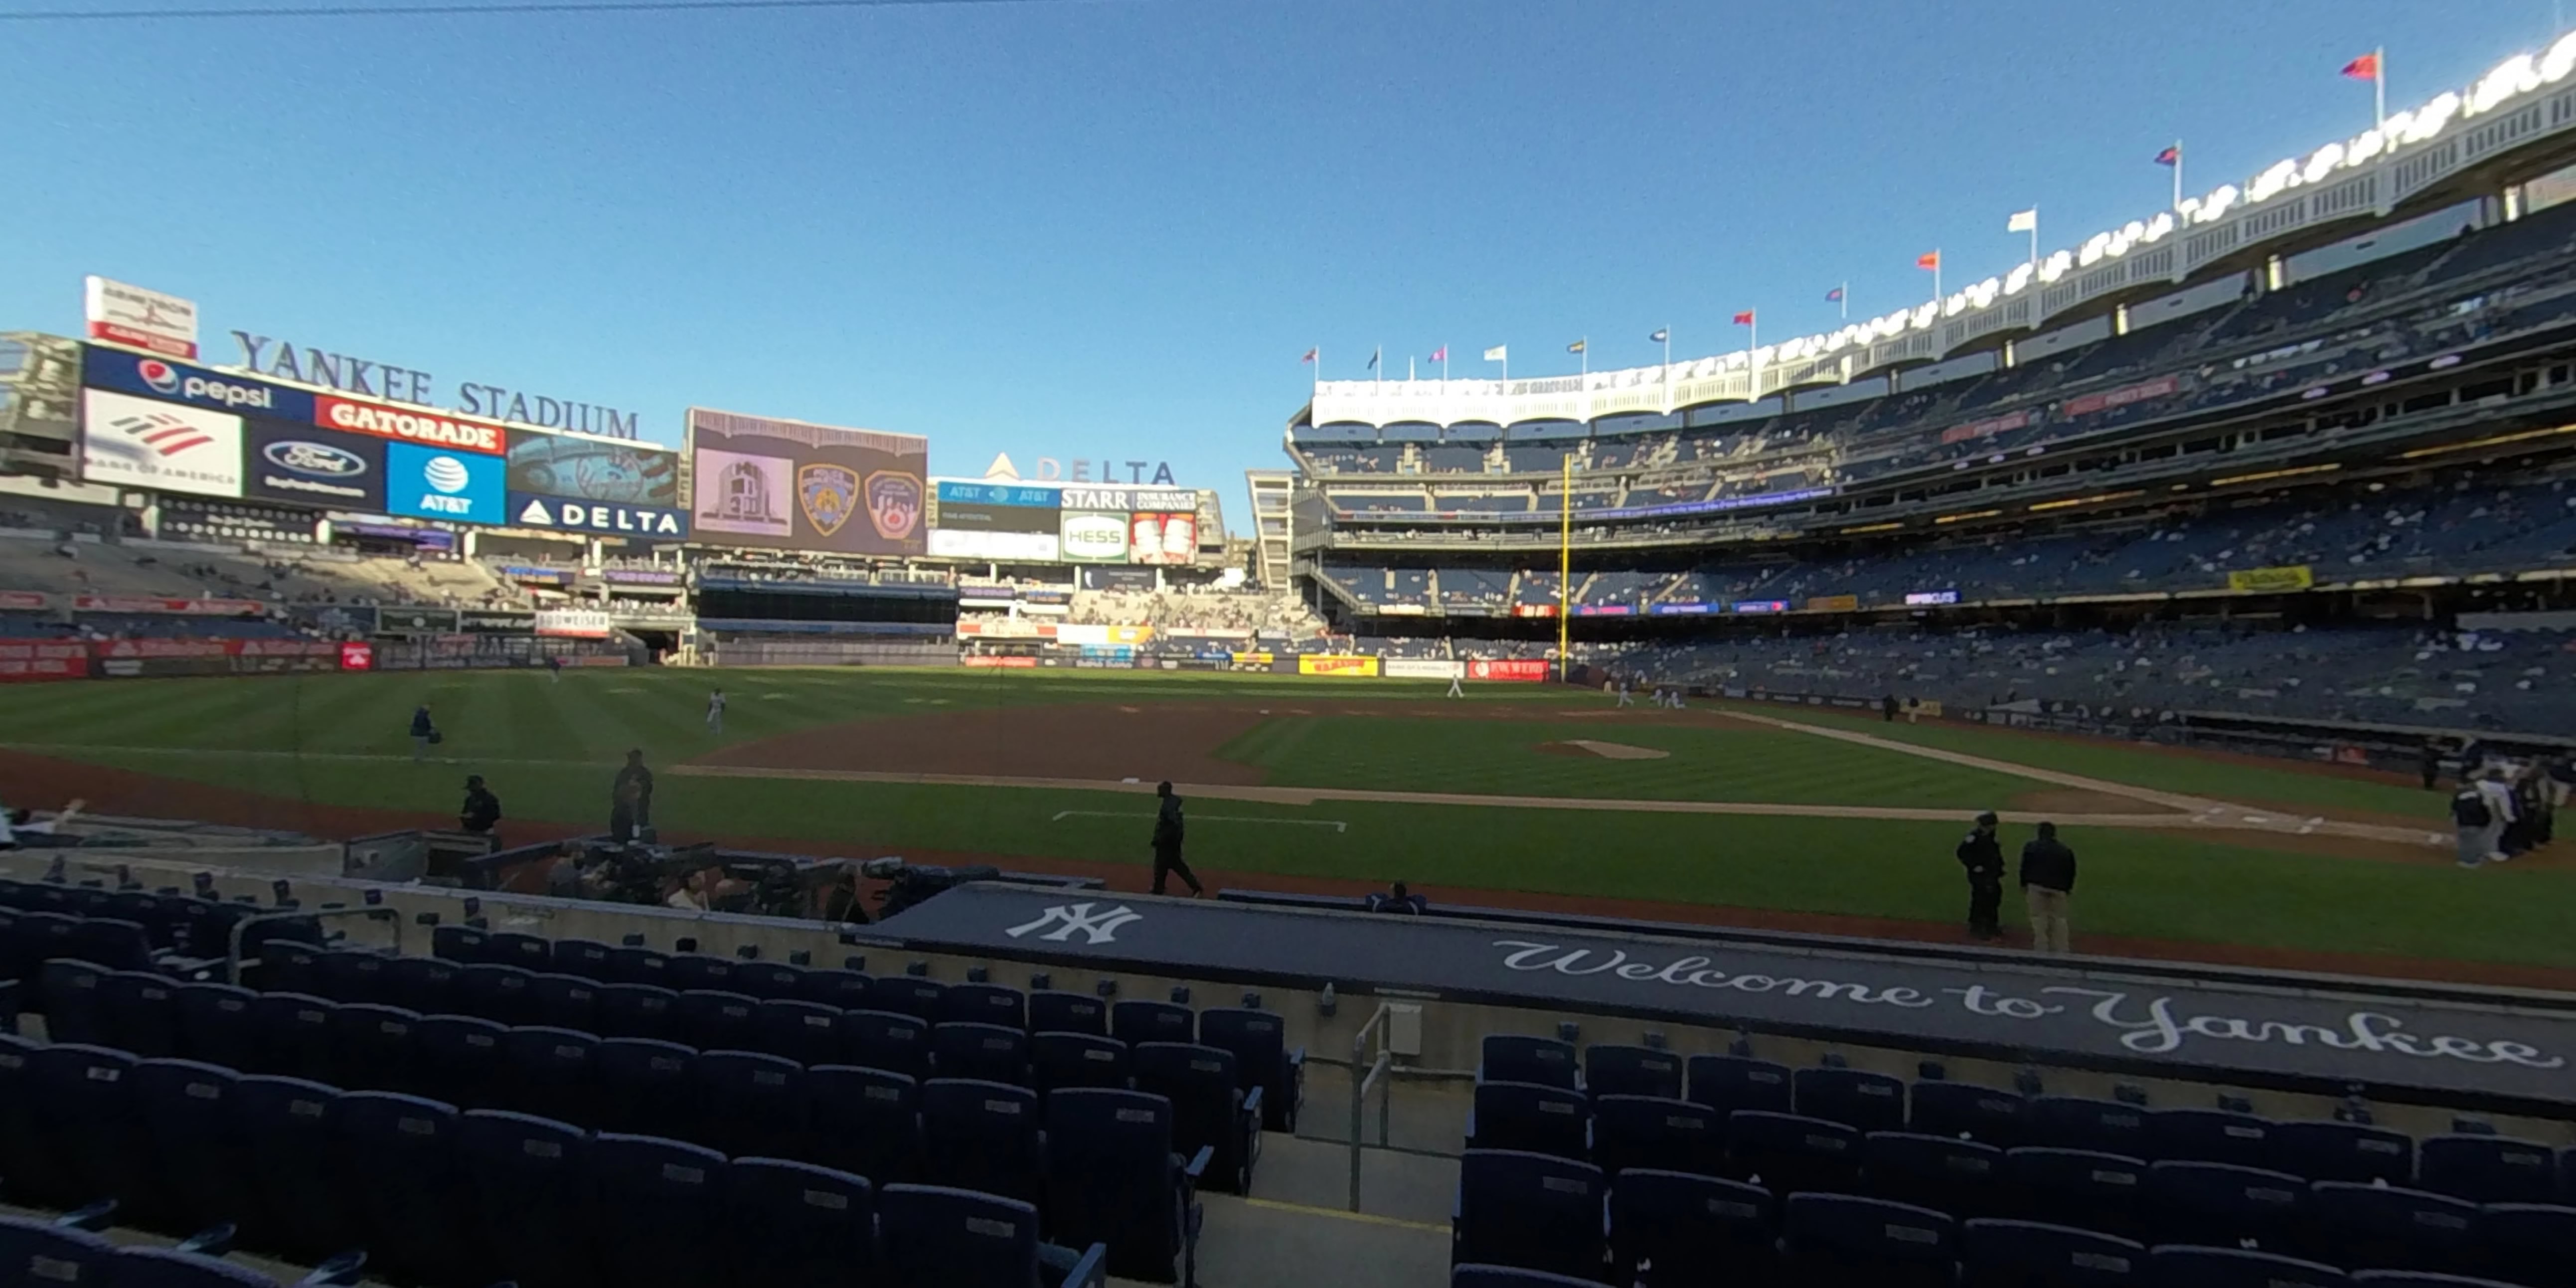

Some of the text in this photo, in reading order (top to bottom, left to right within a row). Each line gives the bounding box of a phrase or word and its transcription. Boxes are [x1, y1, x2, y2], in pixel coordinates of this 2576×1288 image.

[185, 376, 272, 408] pepsi
[230, 330, 433, 406] YANKEE
[458, 382, 640, 441] STADIUM
[330, 403, 496, 449] GATORADE
[284, 445, 348, 472] Ford
[1037, 457, 1175, 485] DELTA
[163, 468, 235, 484] AMERICA
[419, 493, 473, 514] AT&T
[950, 486, 1050, 501] AT&T AT&T
[1061, 489, 1196, 509] STARR INSURANCE
[1136, 501, 1196, 510] COMPANIES
[562, 503, 679, 534] DELTA
[1069, 530, 1121, 544] HESS
[538, 614, 606, 627] BUDWEISER
[1005, 902, 1143, 944] NY
[1492, 940, 2564, 1069] Welcome to Yankee
